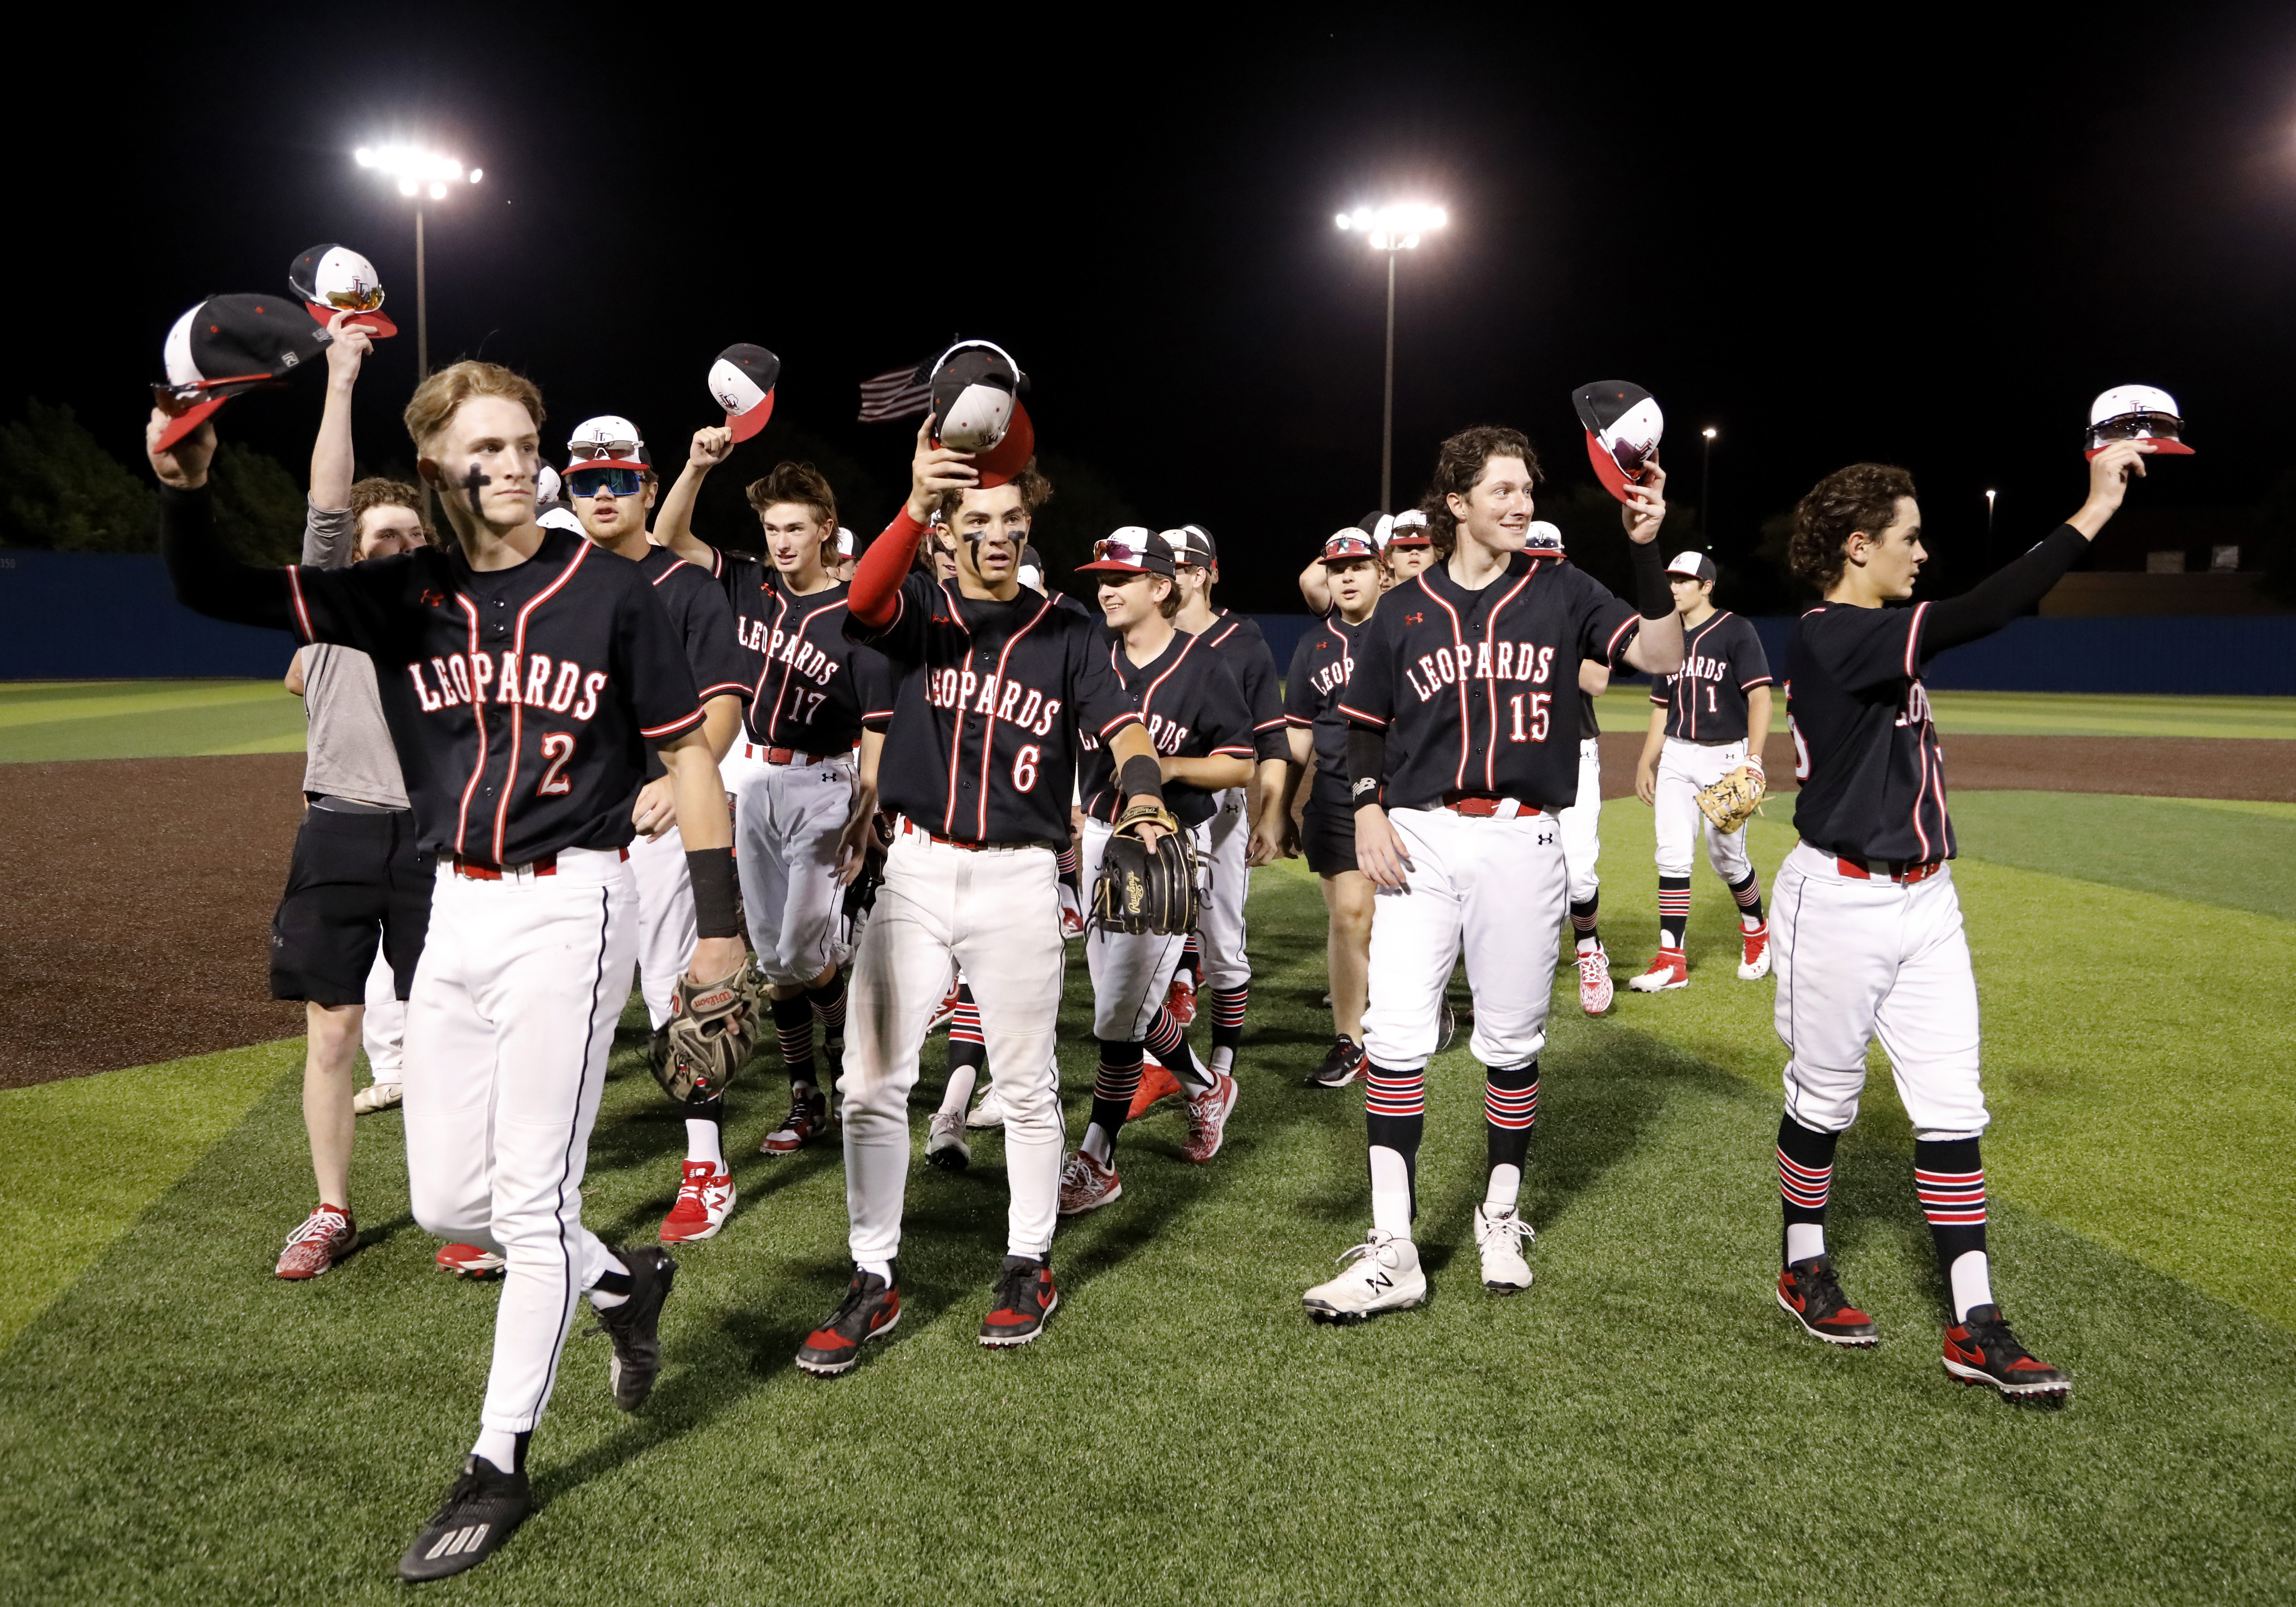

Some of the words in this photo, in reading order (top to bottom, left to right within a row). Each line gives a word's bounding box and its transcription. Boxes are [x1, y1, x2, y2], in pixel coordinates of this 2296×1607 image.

[737, 615, 840, 686] LEOPARDS
[1406, 641, 1555, 702] LEOPARDS
[408, 650, 607, 721] LEOPARDS
[788, 686, 827, 725] 17
[1706, 685, 1717, 713] 1
[1509, 692, 1553, 743] 15
[536, 731, 576, 796] 2
[1012, 744, 1041, 793] 6
[1126, 870, 1142, 914] Rawlings
[694, 991, 732, 1008] Wilson
